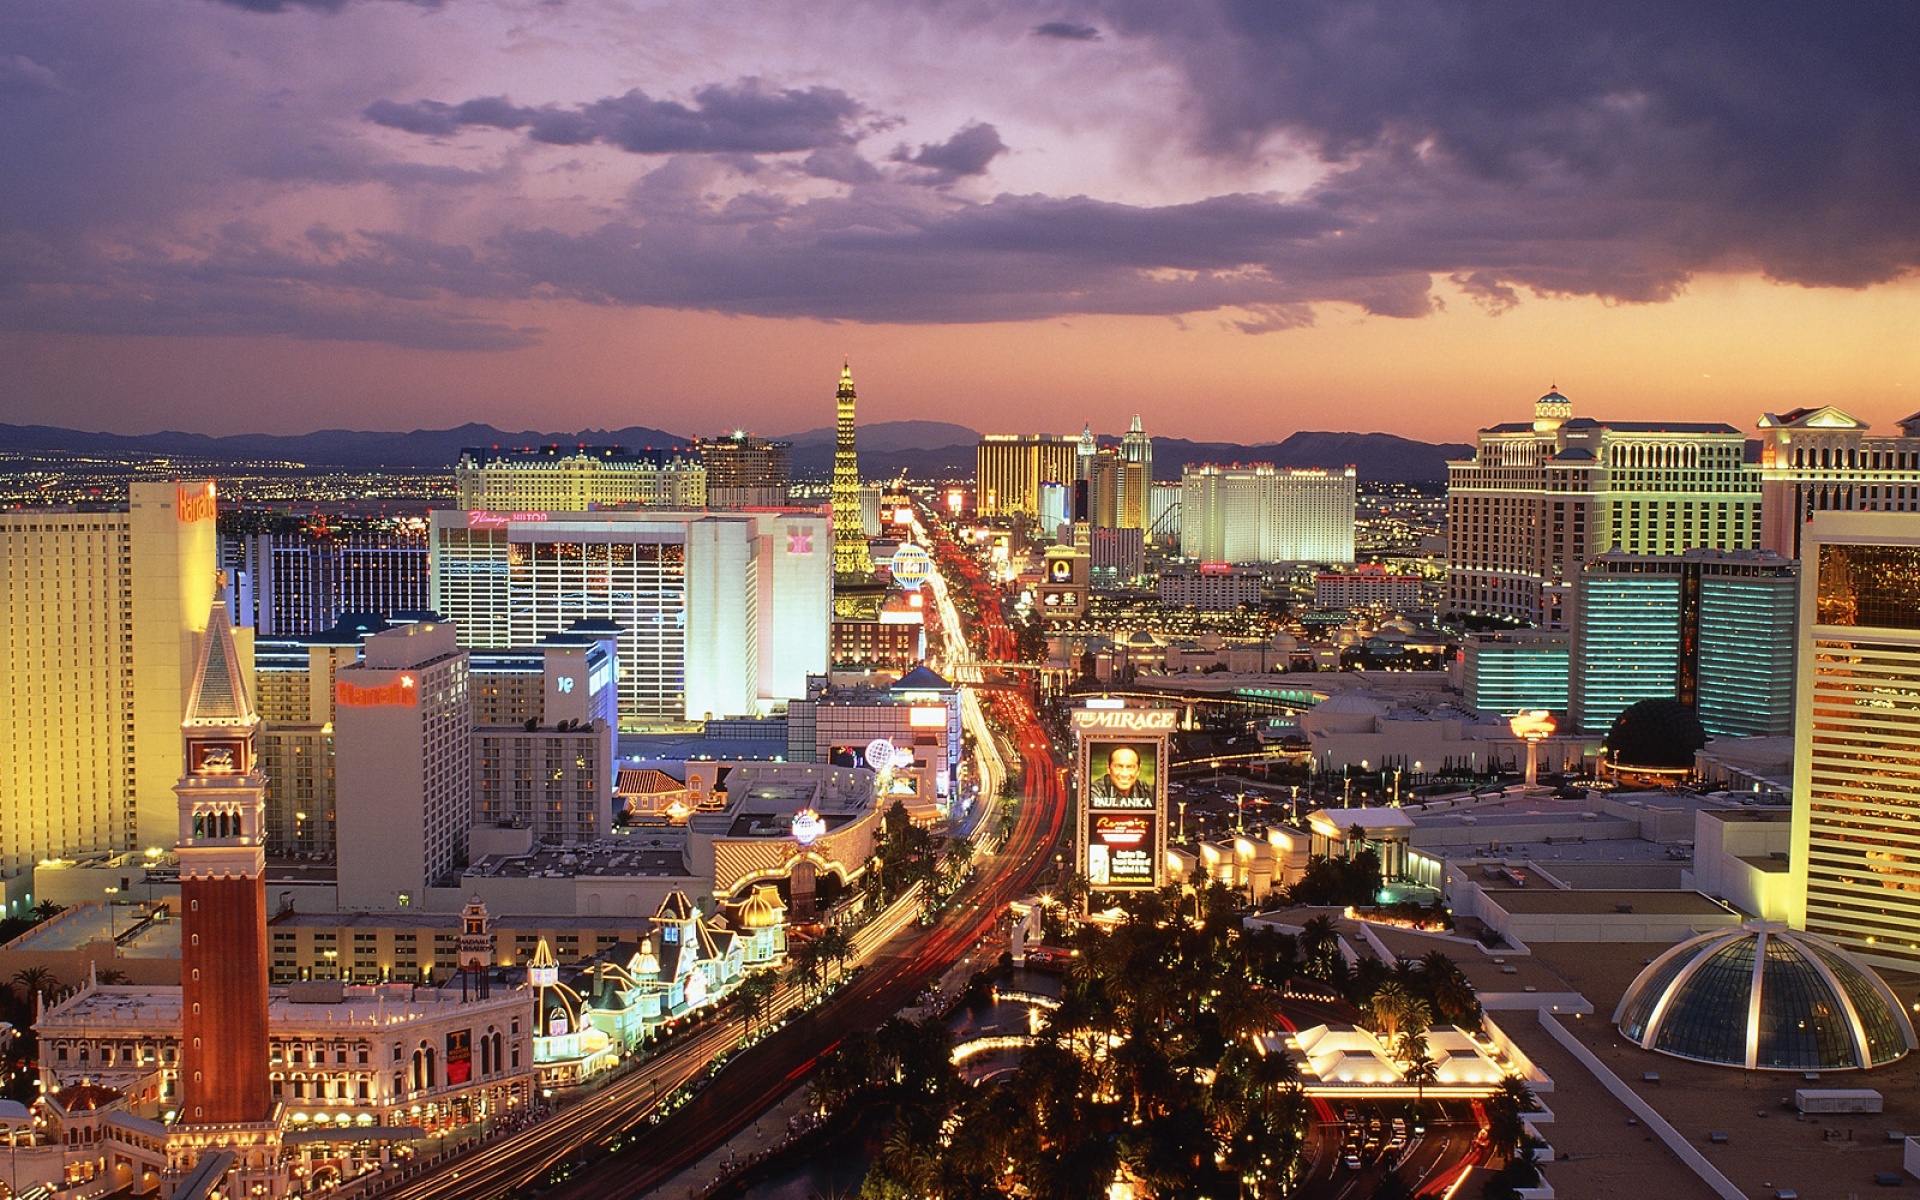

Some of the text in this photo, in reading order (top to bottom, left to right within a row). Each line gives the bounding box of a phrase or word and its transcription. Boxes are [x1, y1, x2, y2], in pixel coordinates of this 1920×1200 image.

[881, 495, 910, 505] MGM
[469, 511, 547, 526] Flamingo HILTON
[1074, 711, 1174, 730] THE MIRAGE
[1093, 797, 1152, 807] PAUL ANKA
[468, 920, 481, 934] T
[451, 1031, 467, 1050] T
